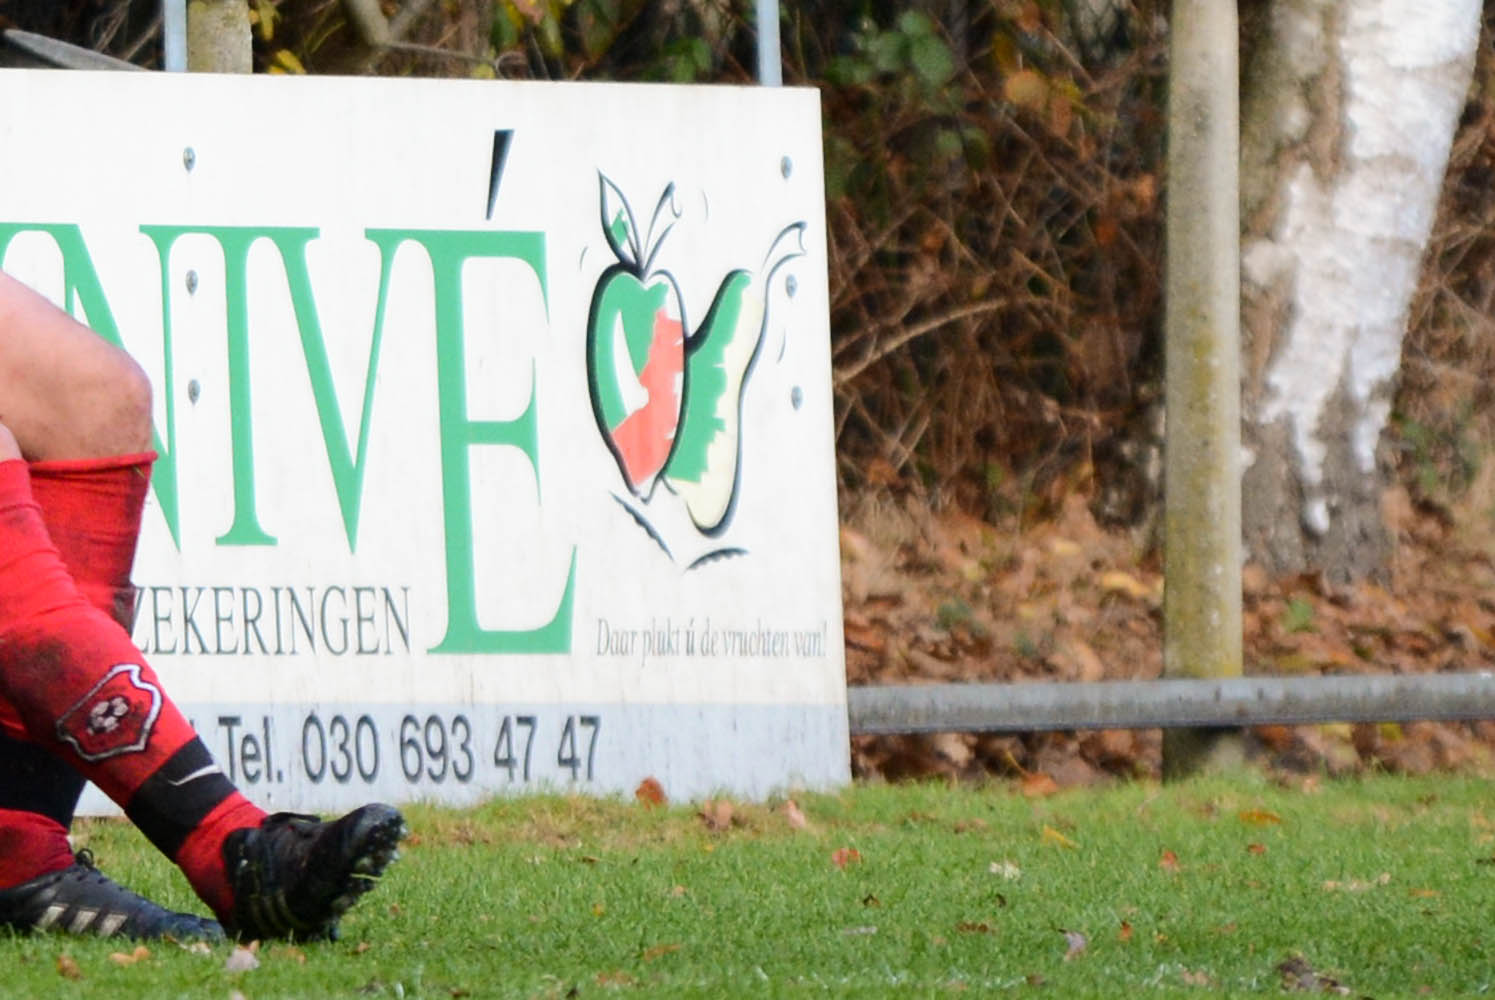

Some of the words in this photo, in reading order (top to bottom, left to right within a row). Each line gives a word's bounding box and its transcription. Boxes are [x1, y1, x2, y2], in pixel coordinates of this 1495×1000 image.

[596, 617, 638, 657] Daar
[641, 617, 681, 668] plukt
[701, 617, 718, 657] de
[723, 617, 790, 657] vruchten
[218, 716, 283, 783] Tel.
[303, 714, 380, 784] 030
[400, 714, 474, 784] 693
[493, 715, 538, 782] 47
[557, 715, 602, 782] 47
